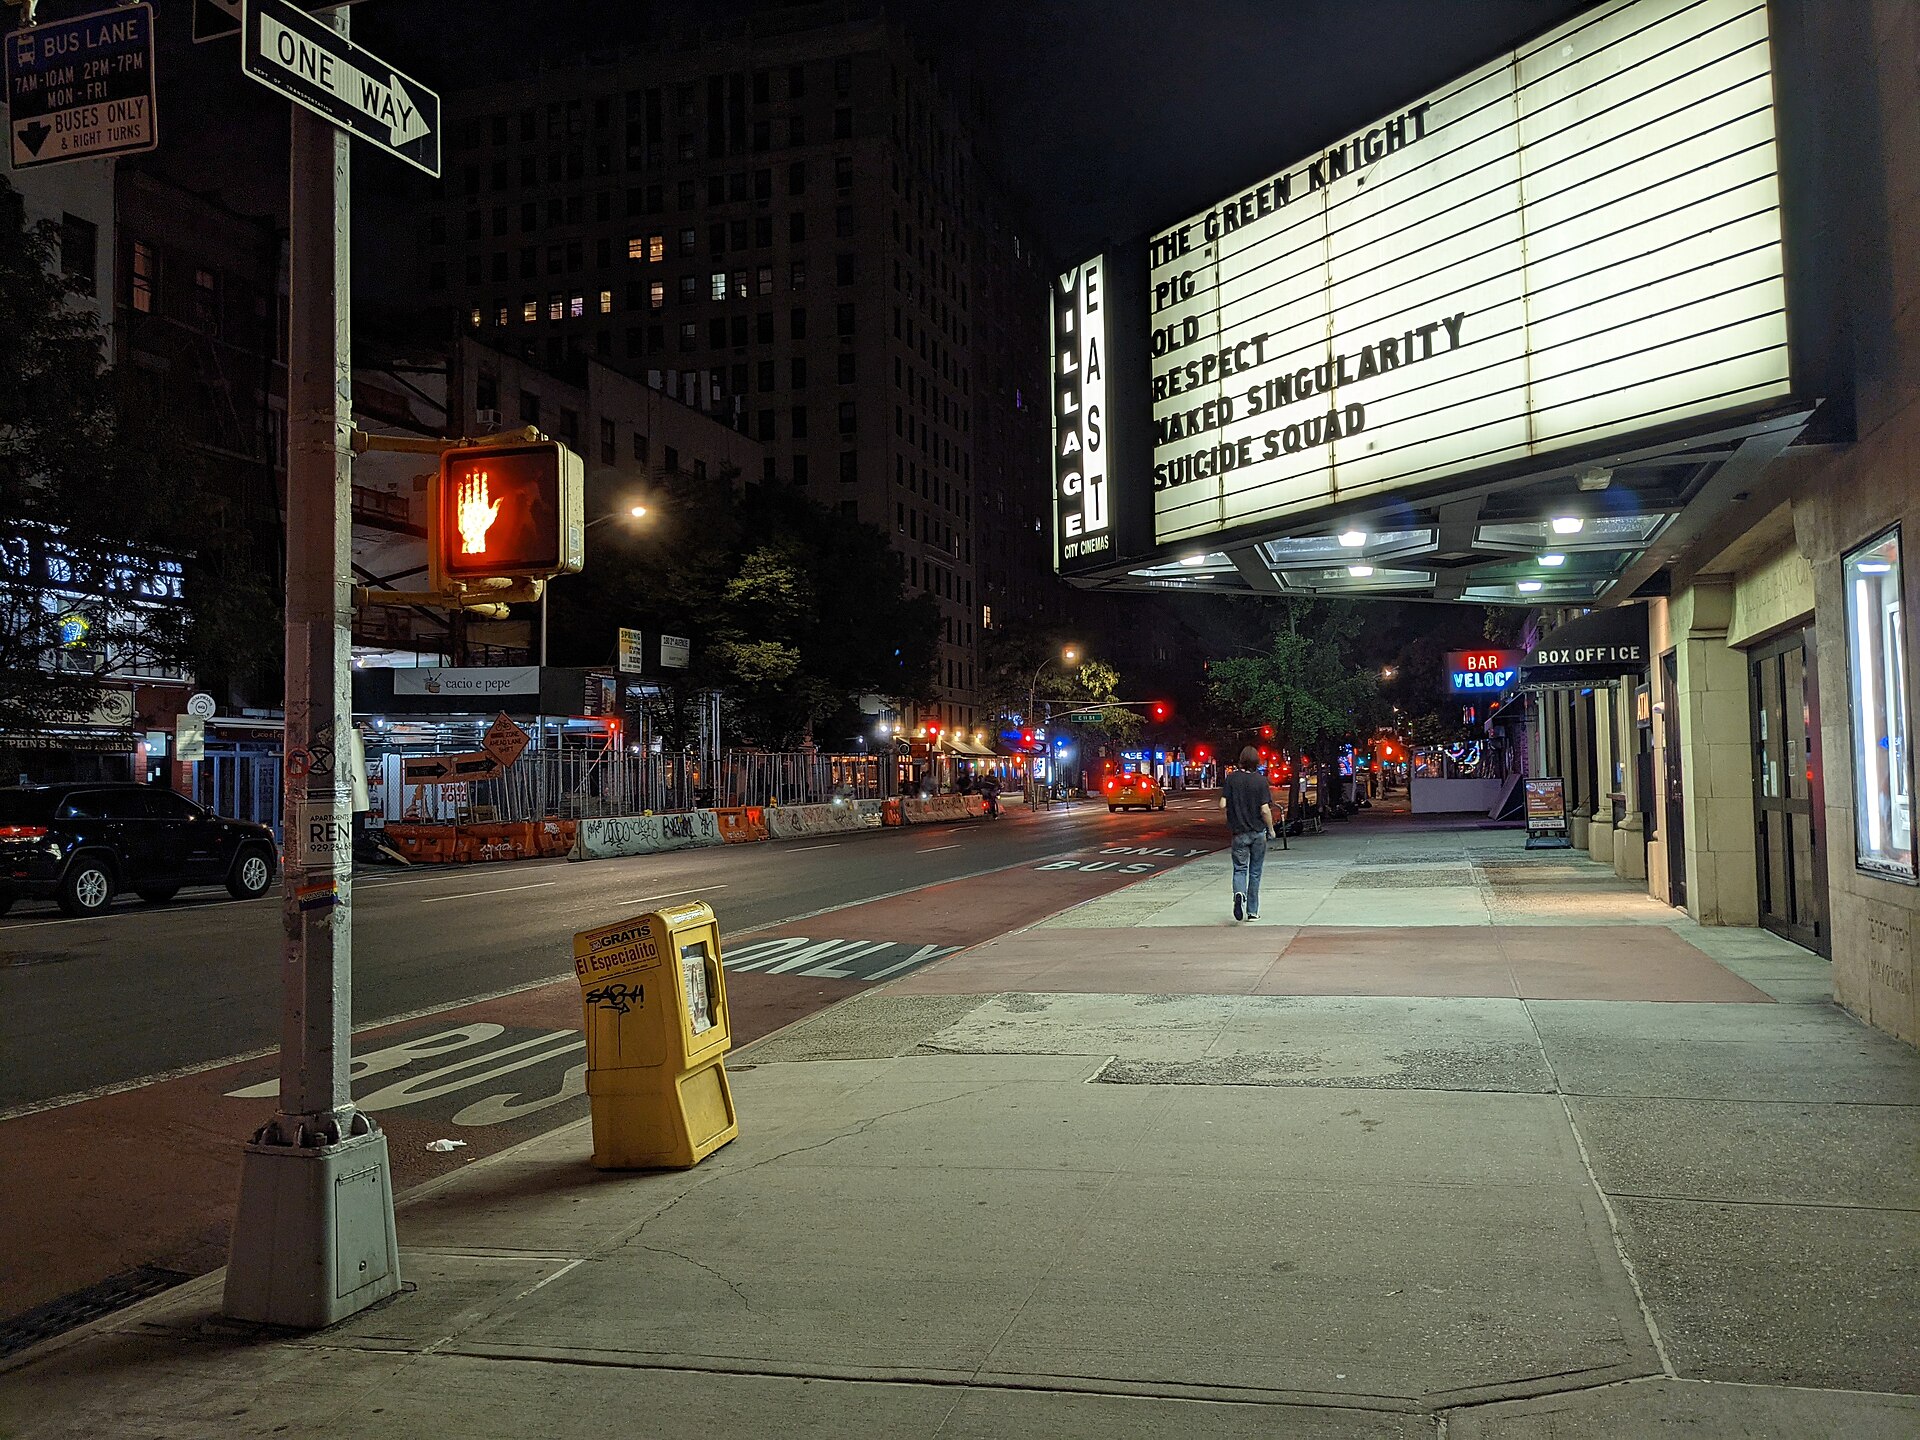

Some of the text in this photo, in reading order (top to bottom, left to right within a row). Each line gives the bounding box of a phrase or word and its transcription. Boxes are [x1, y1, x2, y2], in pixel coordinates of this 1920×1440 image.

[44, 20, 139, 57] BUS LANE
[253, 67, 268, 78] DEPT
[286, 84, 333, 113] TRANSPORTATION
[277, 30, 413, 132] ONE WAY
[55, 99, 144, 133] BUSES ONLY
[61, 125, 141, 150] & RIGHT TURNS
[1151, 101, 1430, 270] THE GREEN KNIGHT
[1155, 270, 1195, 312] PIG
[1152, 315, 1199, 358] OLD
[1154, 332, 1269, 402] RESPECT
[1154, 312, 1465, 447] NAKED SINGULARITY
[1060, 266, 1082, 538] VILLAGE
[1086, 266, 1101, 521] EAST
[1154, 402, 1365, 491] SUICIDE SQUAD
[1064, 535, 1109, 560] CITY CINEMAS
[1468, 656, 1498, 670] BAR
[1538, 646, 1640, 664] BOX OFFICE
[445, 677, 511, 692] cacio e pepe
[310, 814, 349, 822] APARTMENTS
[310, 822, 352, 843] REN
[1035, 859, 1156, 875] BUS
[1099, 846, 1210, 858] ONLY
[601, 925, 651, 947] GRATIS
[576, 958, 589, 976] El
[590, 942, 656, 972] Especialito
[723, 937, 966, 982] ONLY
